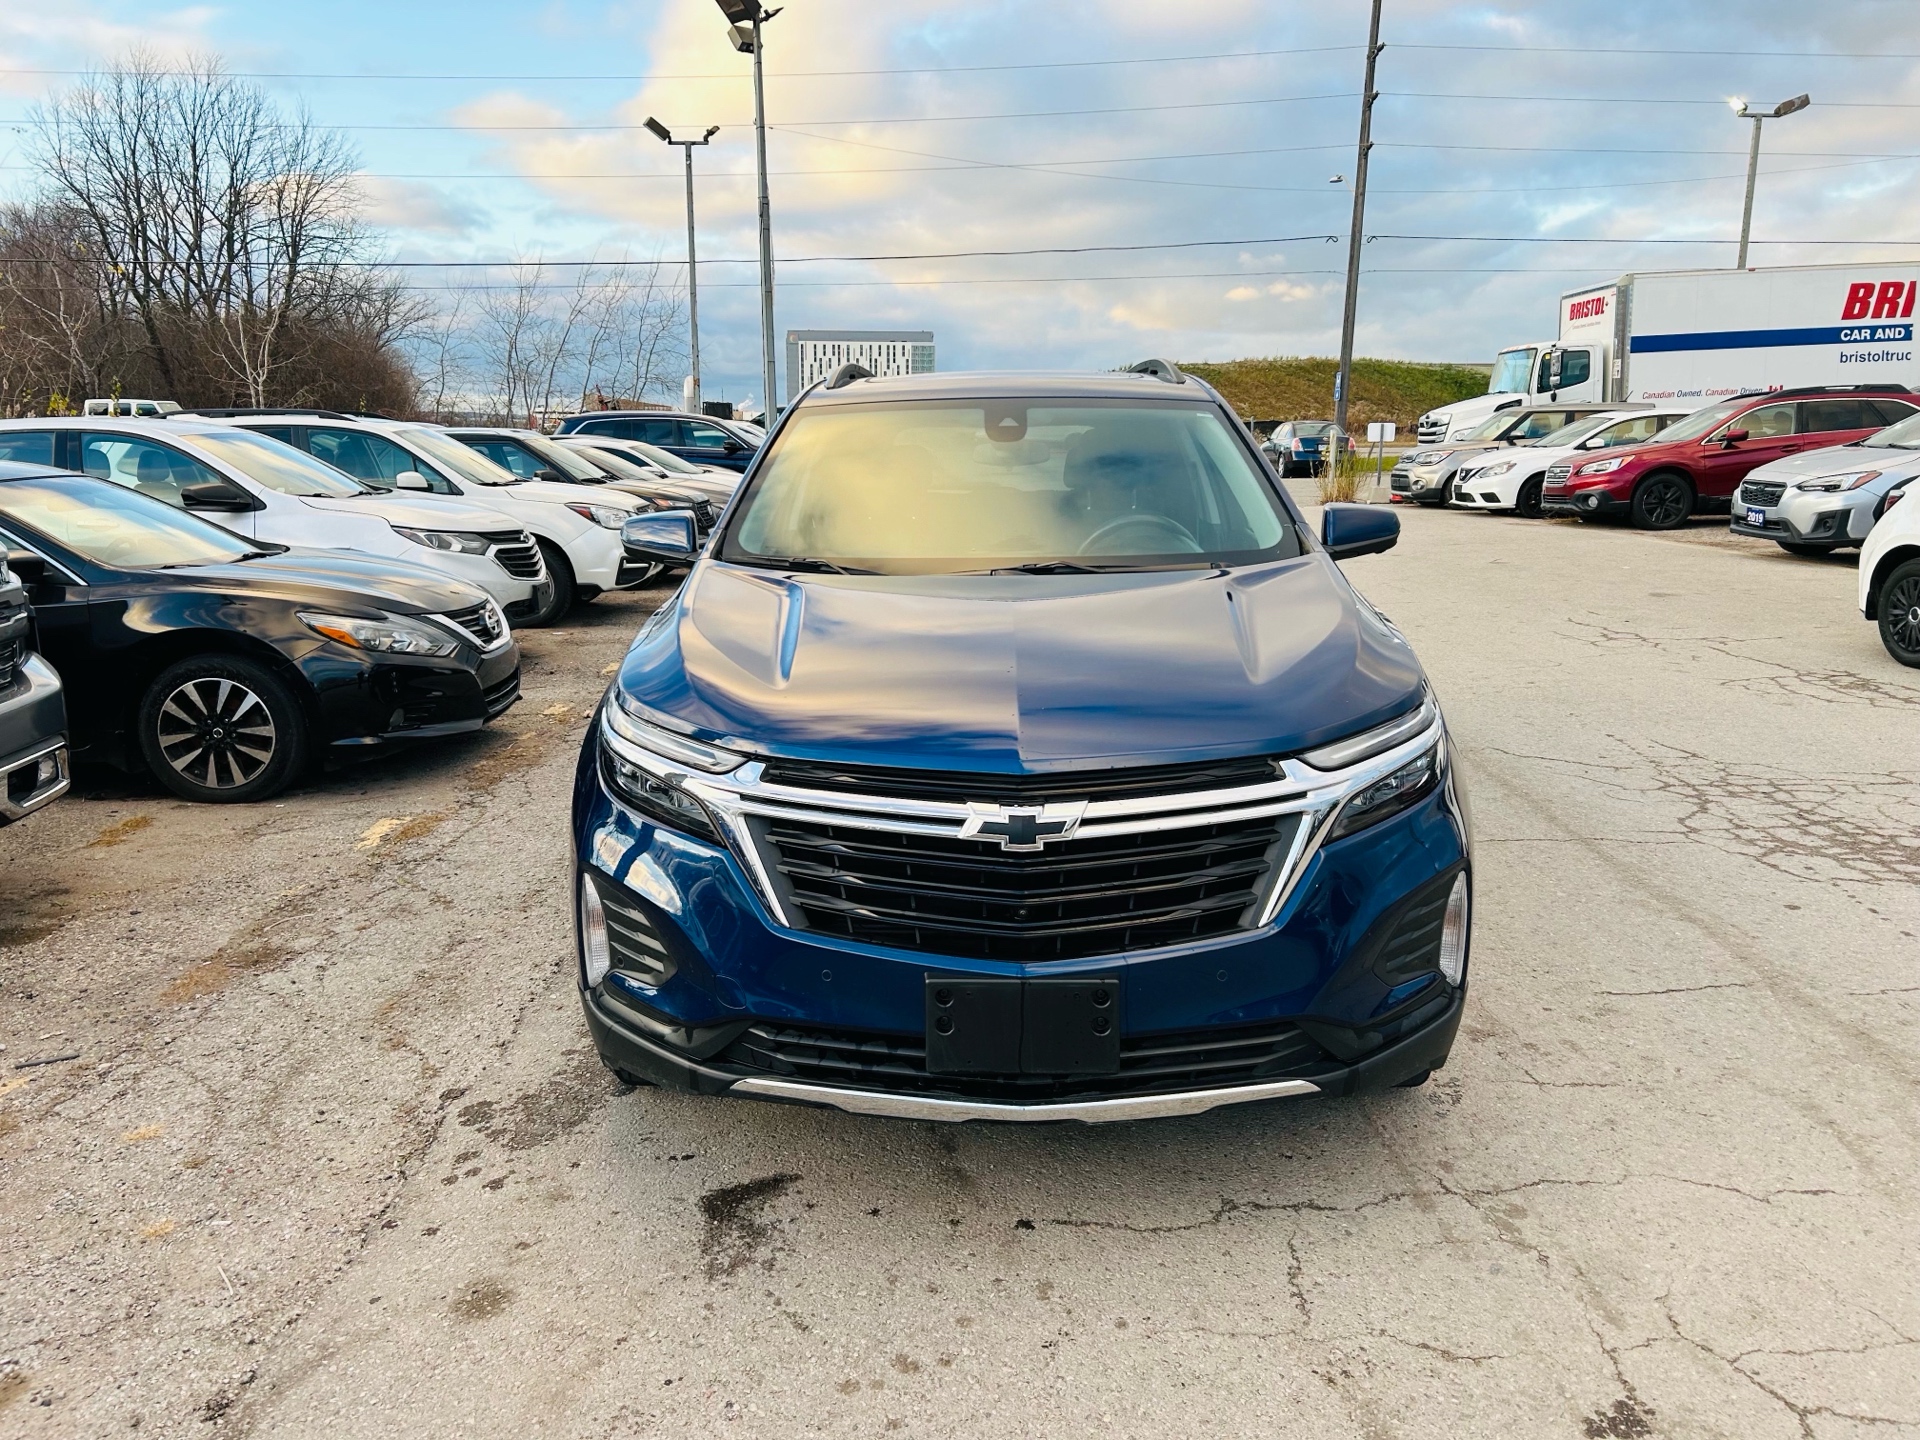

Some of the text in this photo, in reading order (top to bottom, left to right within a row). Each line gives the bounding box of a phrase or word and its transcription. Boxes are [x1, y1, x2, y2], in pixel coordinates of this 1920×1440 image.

[1841, 281, 1917, 320] BRI
[1570, 296, 1605, 321] BRISTOL
[1840, 329, 1871, 341] CAR
[1874, 327, 1905, 340] AND
[1840, 350, 1912, 364] bristoltruc
[1643, 390, 1675, 400] Canadian
[1705, 387, 1738, 397] Canadian
[1747, 511, 1763, 523] 2019
